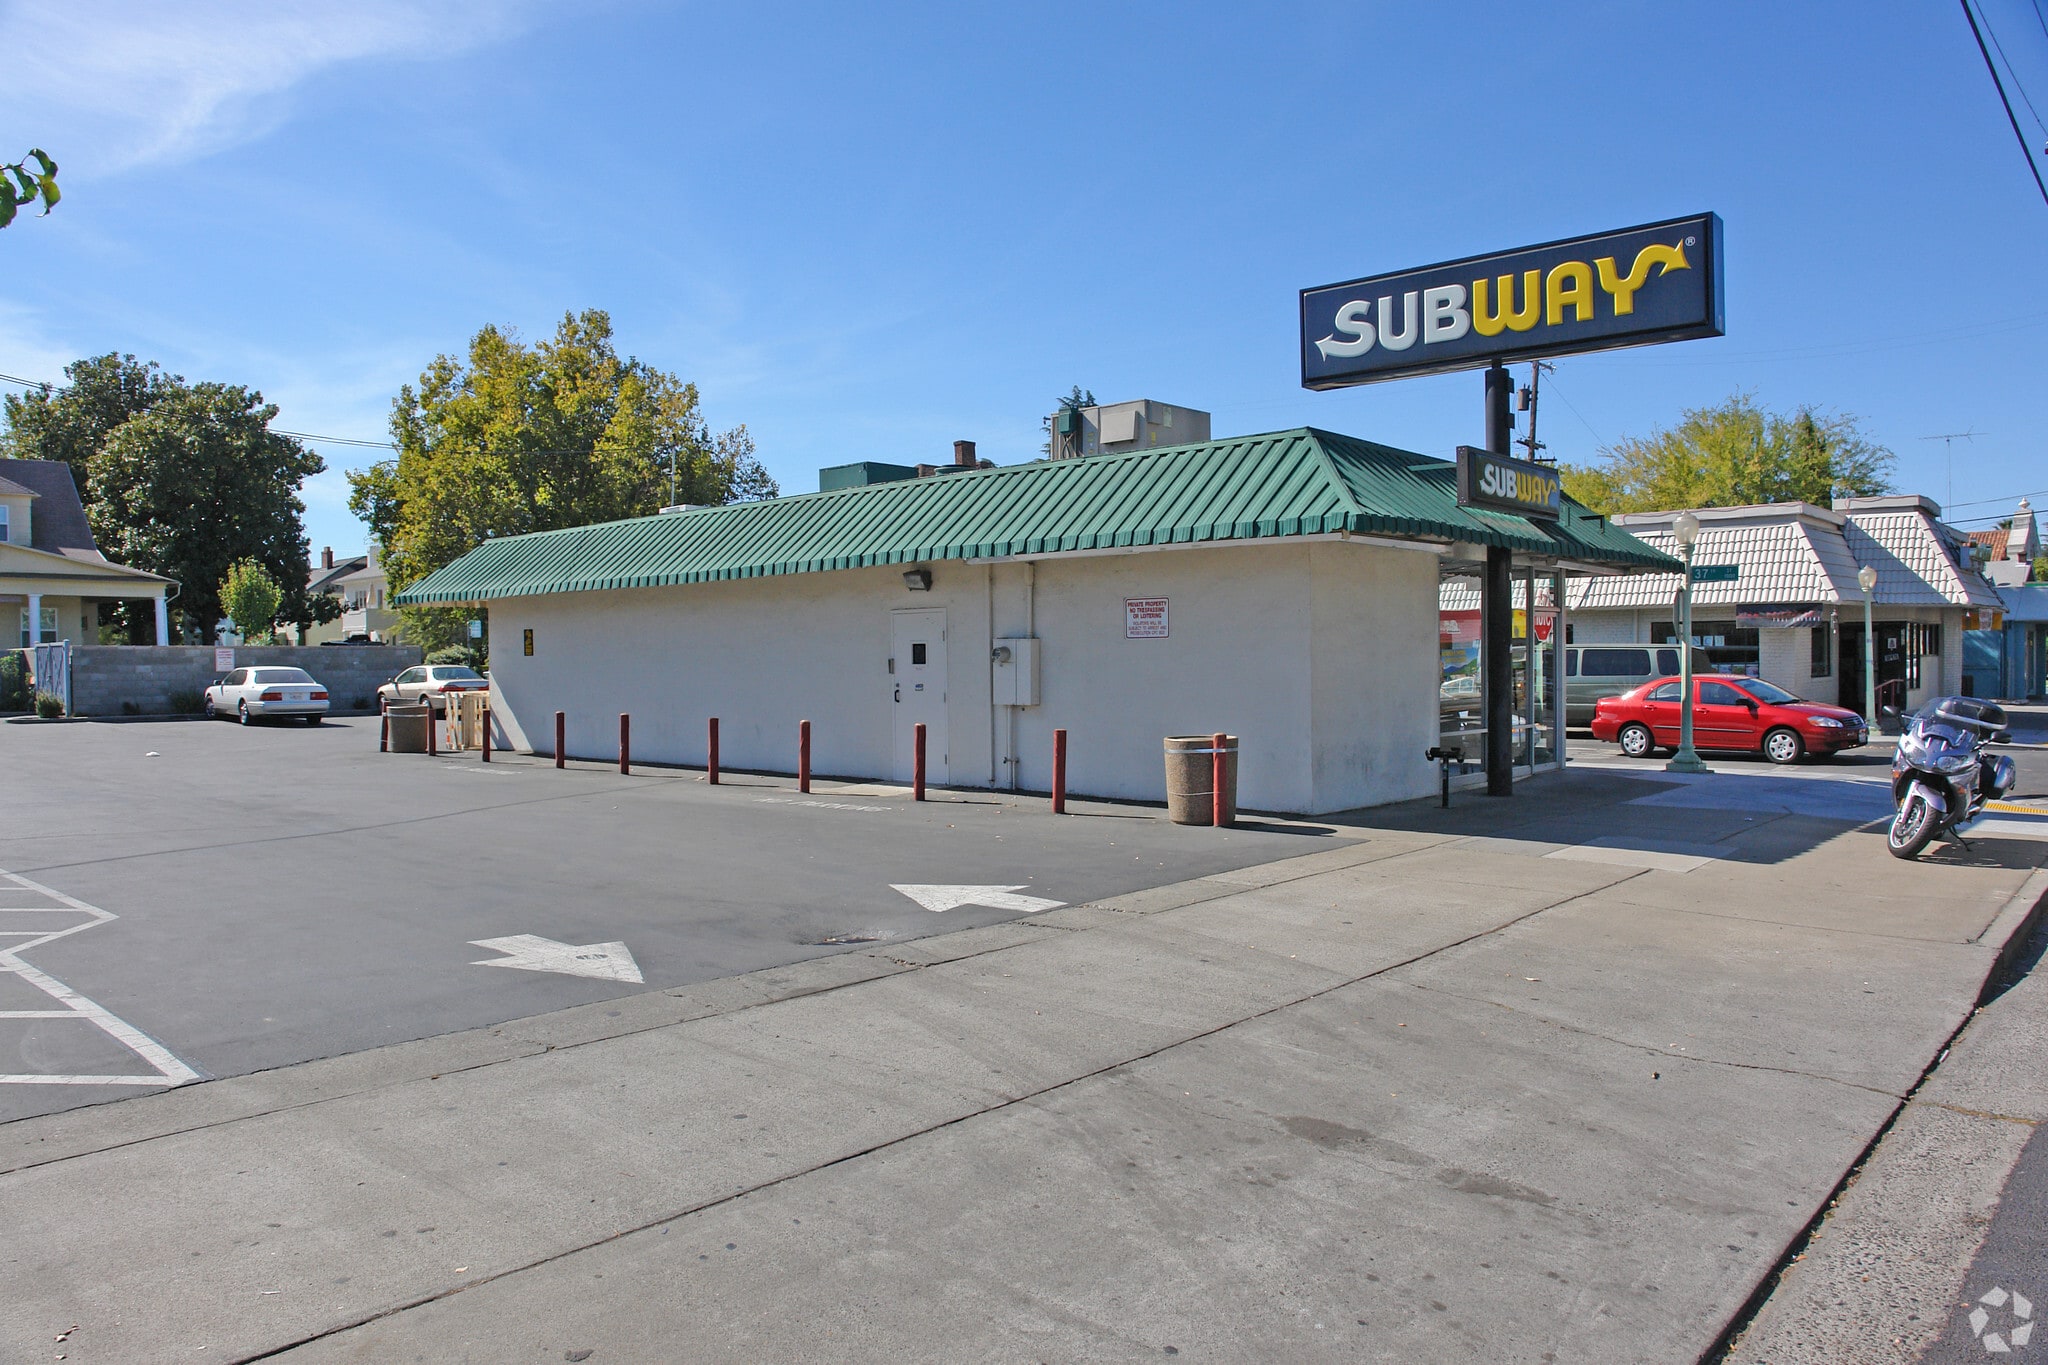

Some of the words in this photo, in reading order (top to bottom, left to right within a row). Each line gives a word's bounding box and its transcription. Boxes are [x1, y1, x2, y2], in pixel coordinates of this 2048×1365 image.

[1314, 238, 1691, 362] SUBWAY
[1479, 463, 1557, 506] SUBWAY
[1695, 568, 1709, 579] 37
